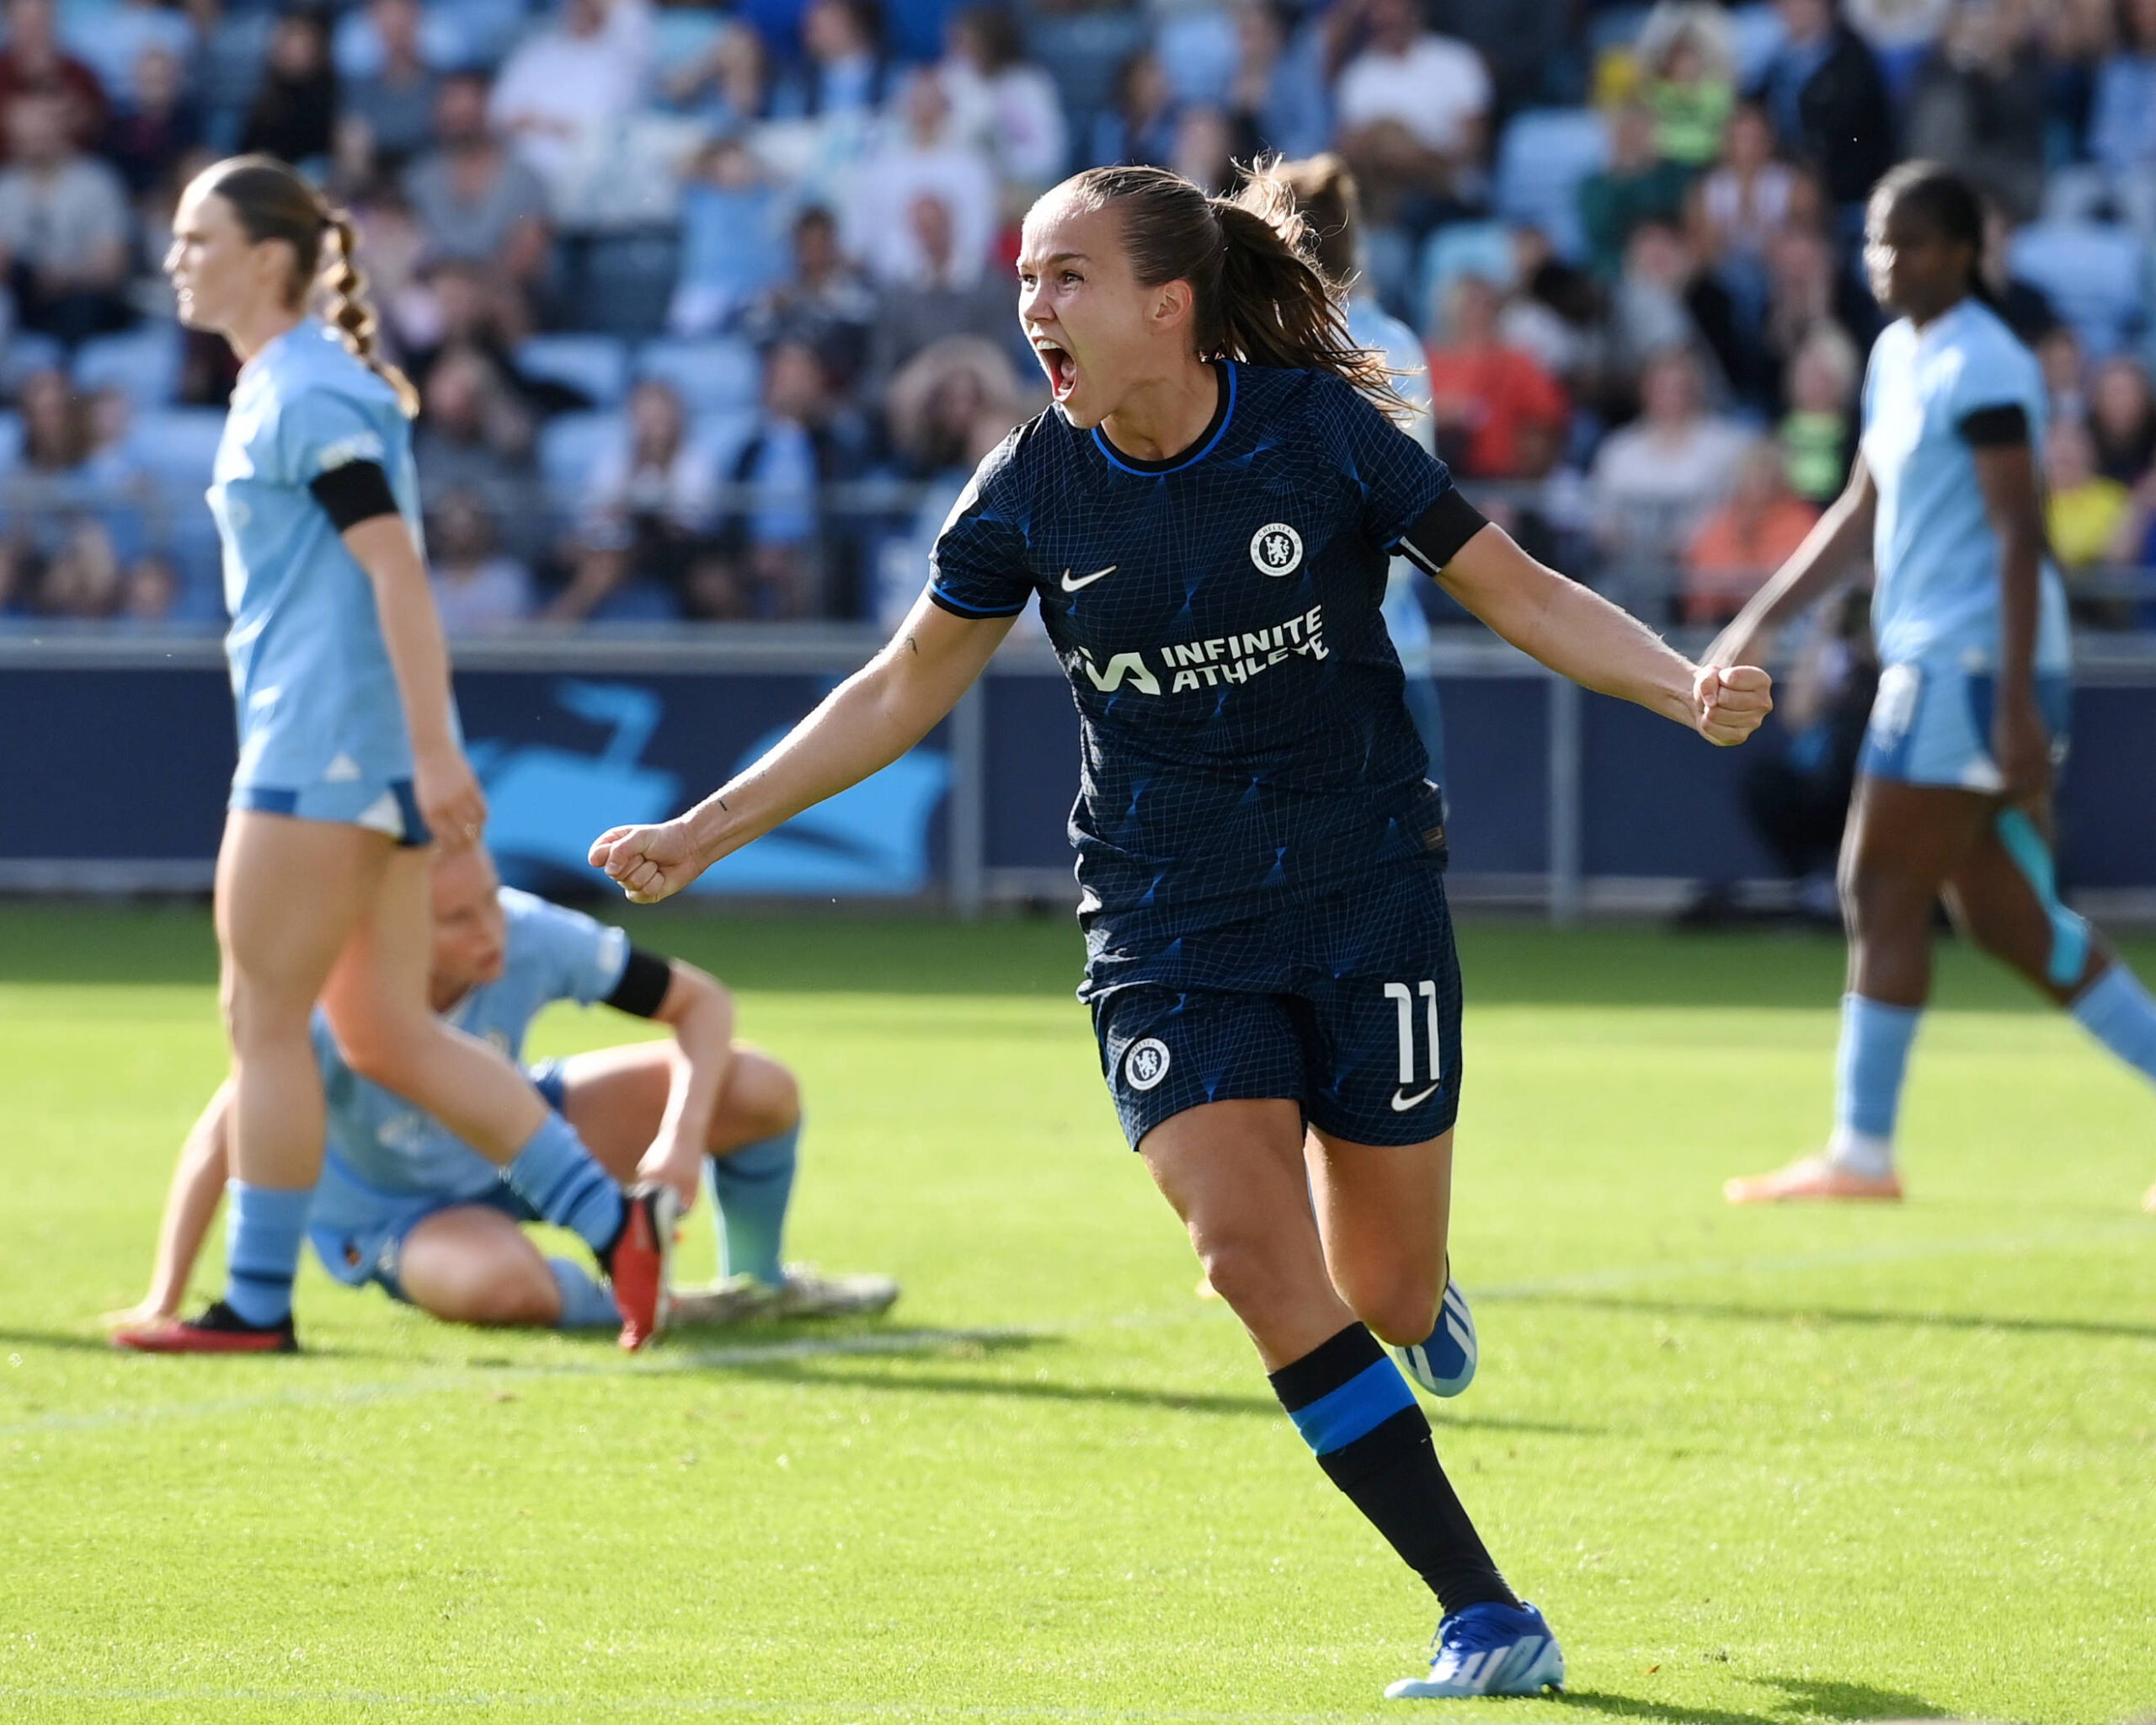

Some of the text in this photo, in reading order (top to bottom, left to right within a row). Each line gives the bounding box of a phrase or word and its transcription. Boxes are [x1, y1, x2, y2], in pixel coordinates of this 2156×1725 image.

[1257, 526, 1291, 538] CHELSEA
[1161, 604, 1323, 668] INFINITE
[1384, 980, 1440, 1083] 11
